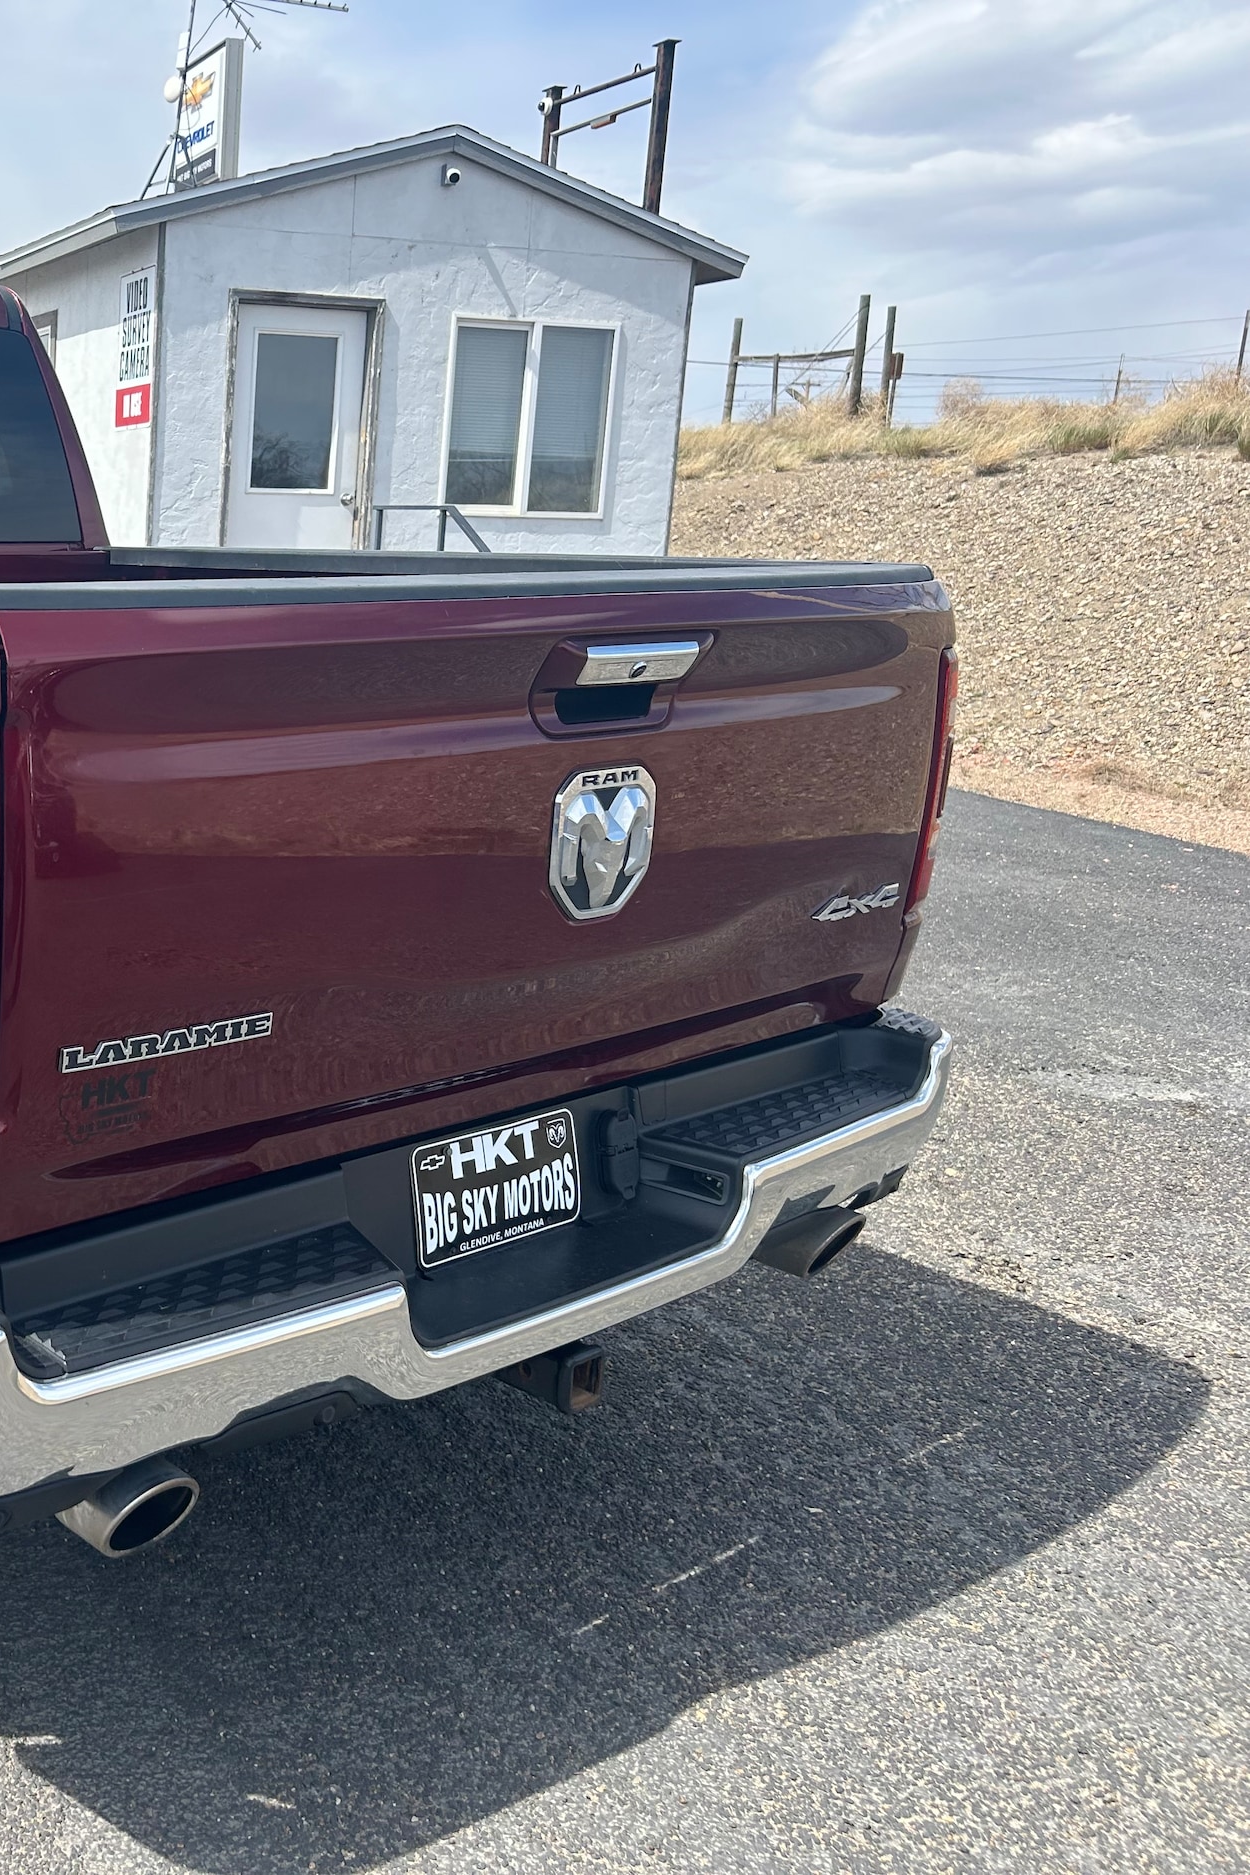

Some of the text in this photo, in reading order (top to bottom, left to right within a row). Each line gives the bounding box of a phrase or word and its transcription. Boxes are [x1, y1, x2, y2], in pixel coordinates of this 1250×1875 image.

[177, 120, 215, 154] CEVROLET
[126, 277, 148, 313] VIDEO
[122, 309, 151, 348] SURVEY
[119, 345, 149, 381] CAMERA
[581, 769, 639, 788] RAM
[59, 1011, 273, 1074] LARAMIE
[81, 1067, 157, 1111] HKT
[450, 1120, 539, 1179] HKT
[422, 1152, 576, 1255] BIG SKY MOTORS
[459, 1217, 545, 1252] GLENDIVE, MONTANA
